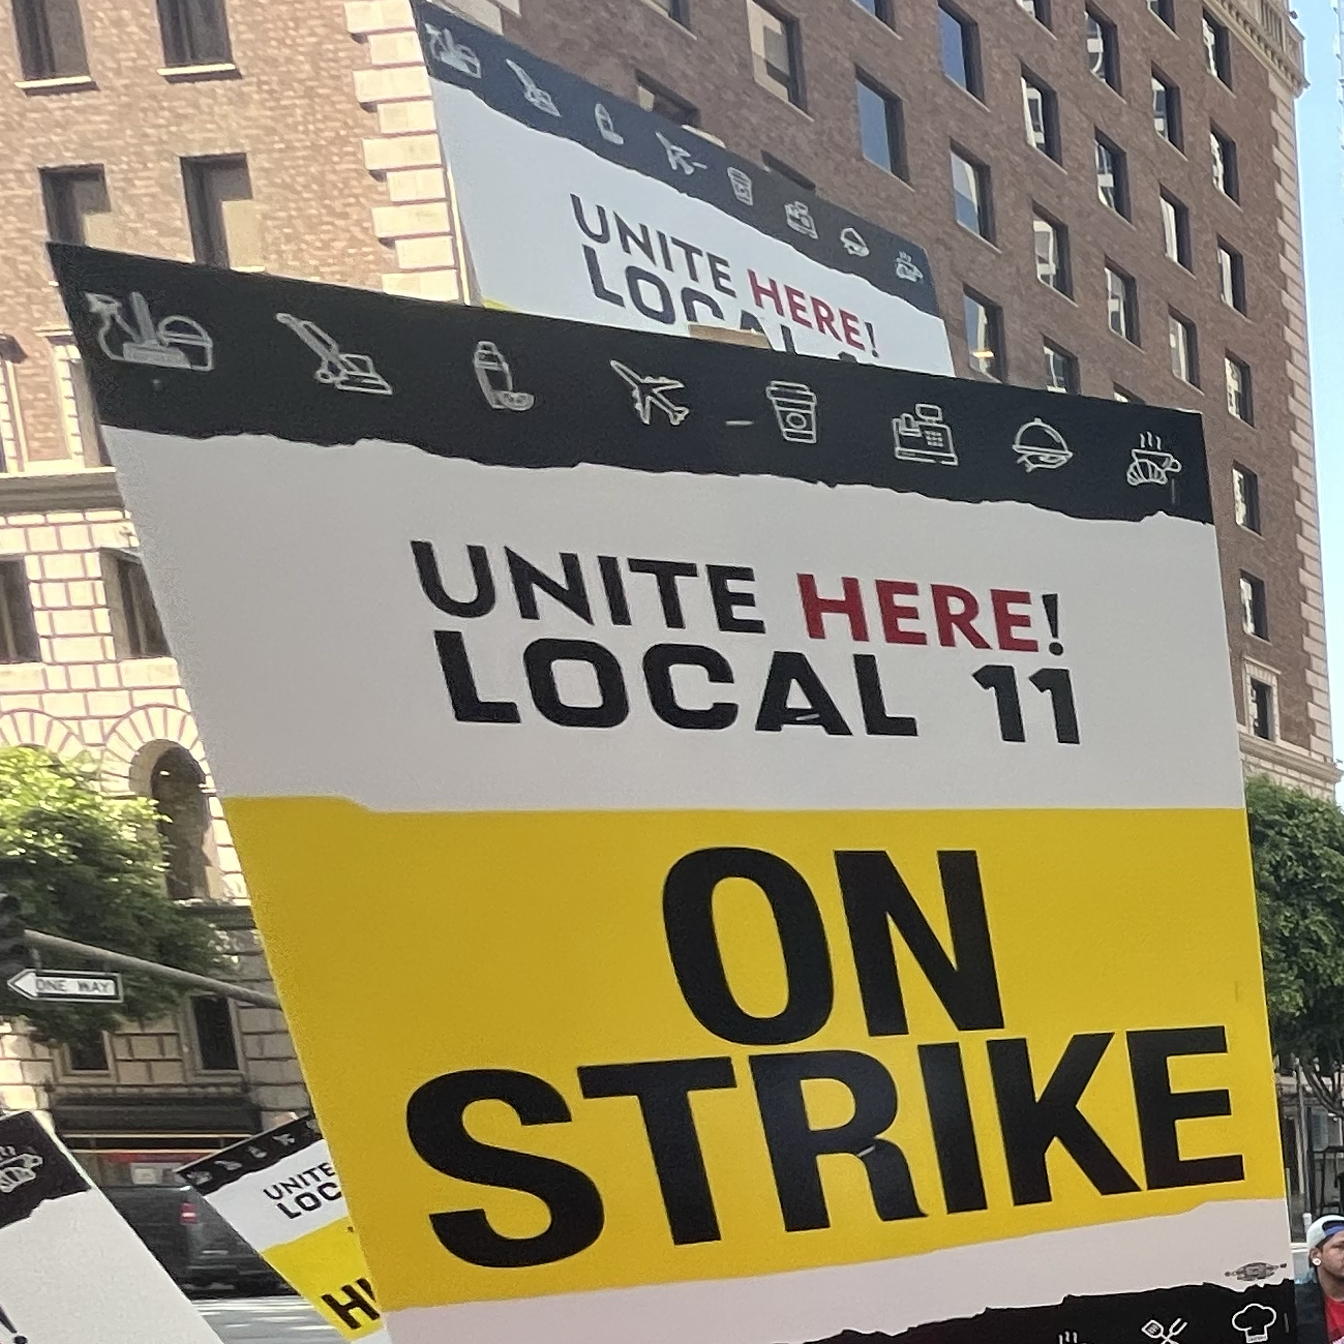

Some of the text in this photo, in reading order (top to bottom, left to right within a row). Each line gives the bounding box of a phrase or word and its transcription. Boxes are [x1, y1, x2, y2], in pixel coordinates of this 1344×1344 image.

[569, 193, 880, 358] UNITE HERE!
[410, 541, 1065, 656] UNITE HERE!
[434, 629, 1081, 745] LOCAL 11
[36, 979, 111, 993] ONE WAY
[661, 846, 1006, 1047] ON
[263, 1162, 336, 1200] UNITE
[276, 1182, 343, 1219] LOC
[406, 1024, 1246, 1270] STRIKE
